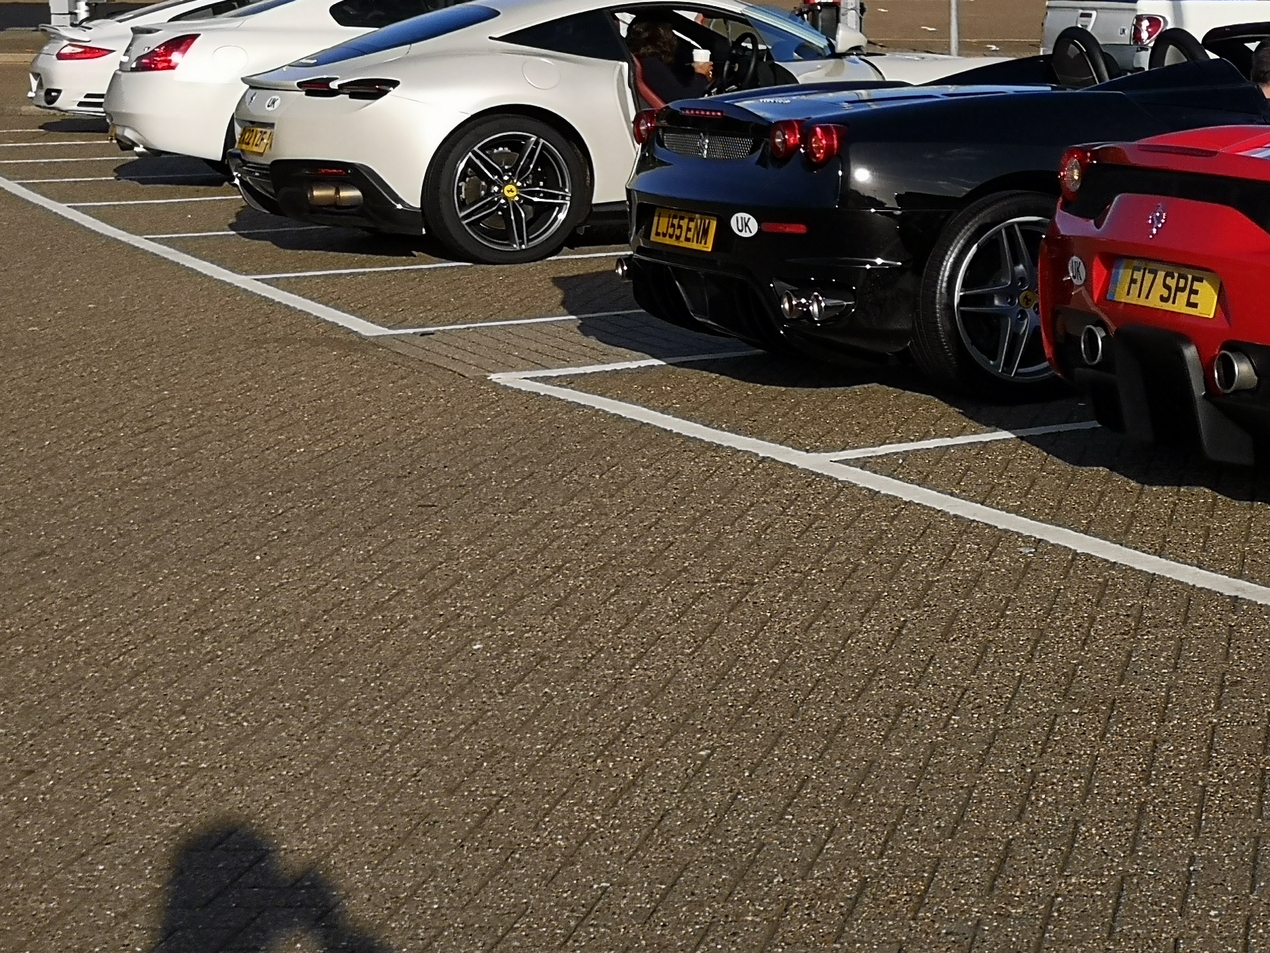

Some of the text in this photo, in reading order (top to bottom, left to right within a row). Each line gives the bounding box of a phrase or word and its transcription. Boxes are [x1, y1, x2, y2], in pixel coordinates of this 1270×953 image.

[266, 97, 280, 108] UK
[655, 211, 711, 246] LJ55 ENM
[736, 215, 752, 234] UK
[1070, 260, 1083, 281] UK
[1126, 264, 1204, 309] F17 SPE
